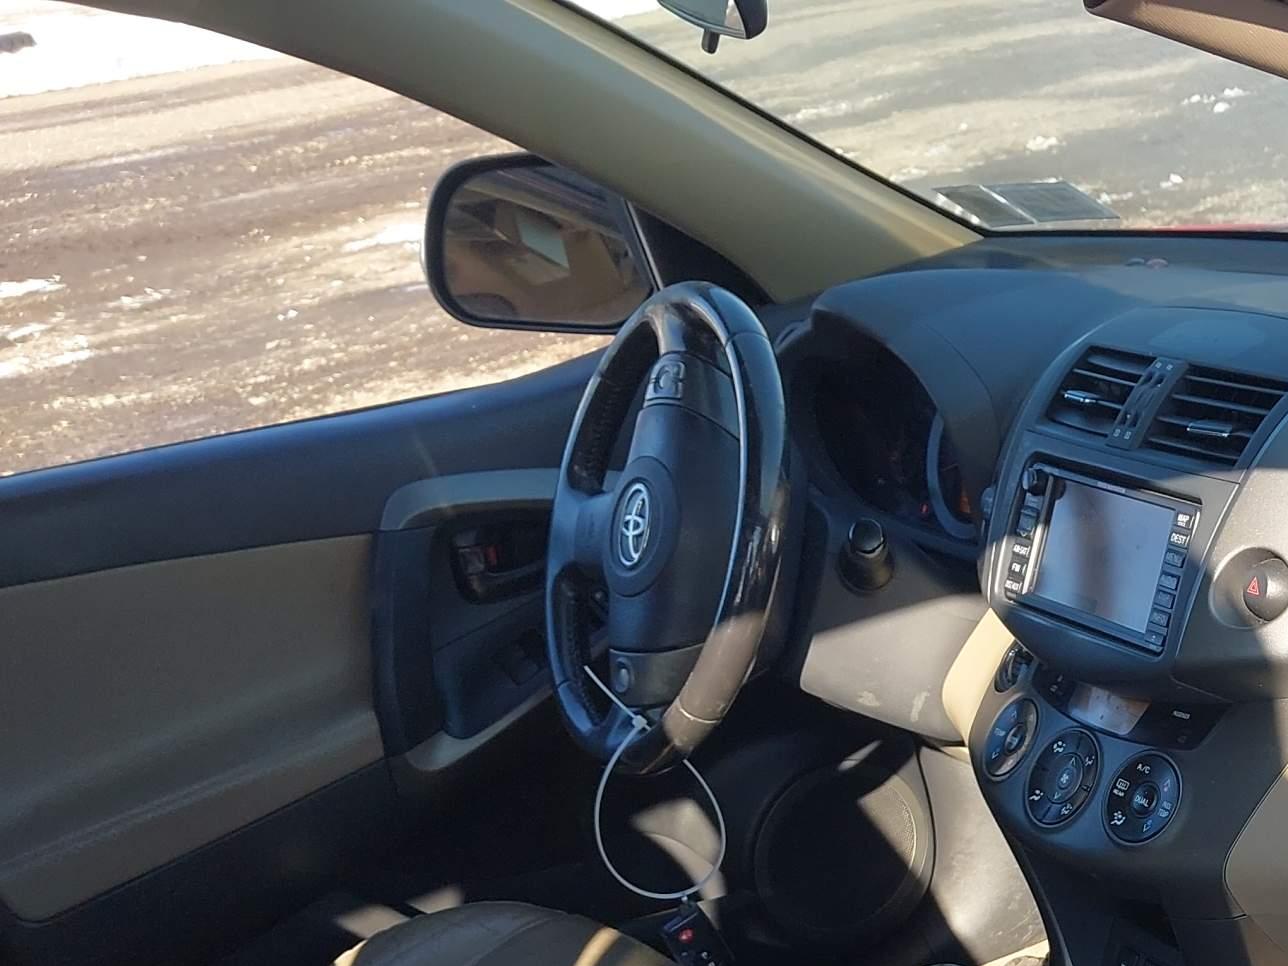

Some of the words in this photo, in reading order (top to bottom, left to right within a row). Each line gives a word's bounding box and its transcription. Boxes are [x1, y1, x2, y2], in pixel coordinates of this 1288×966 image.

[1170, 532, 1187, 545] DEST
[1136, 763, 1151, 774] A/C
[1134, 794, 1149, 808] DUAL
